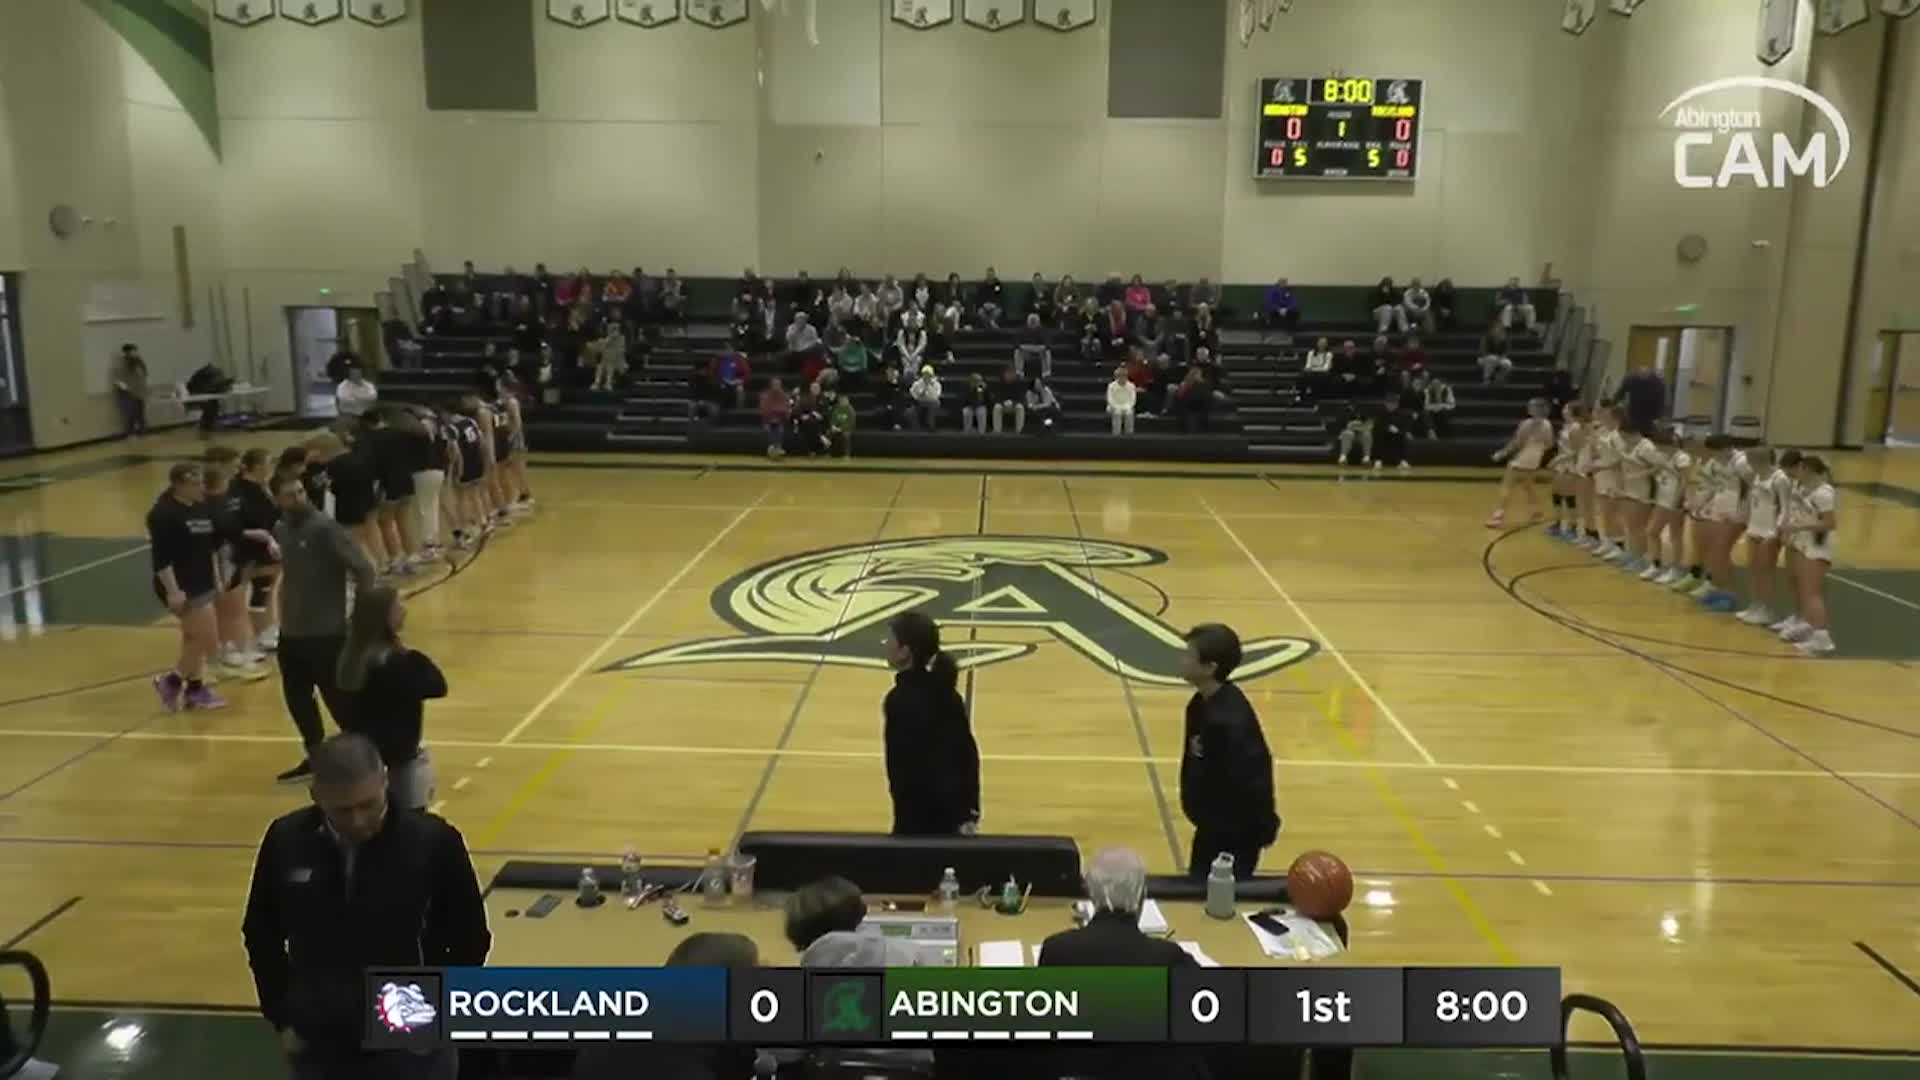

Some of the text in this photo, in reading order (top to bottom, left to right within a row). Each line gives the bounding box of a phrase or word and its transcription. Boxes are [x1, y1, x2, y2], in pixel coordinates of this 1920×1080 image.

[1324, 79, 1371, 102] 8:00
[1287, 117, 1301, 140] 0
[1338, 120, 1346, 138] 1
[1395, 119, 1410, 140] 0
[1271, 148, 1283, 166] 0
[1294, 148, 1307, 167] 5
[1367, 149, 1380, 168] 5
[1396, 150, 1409, 168] 0
